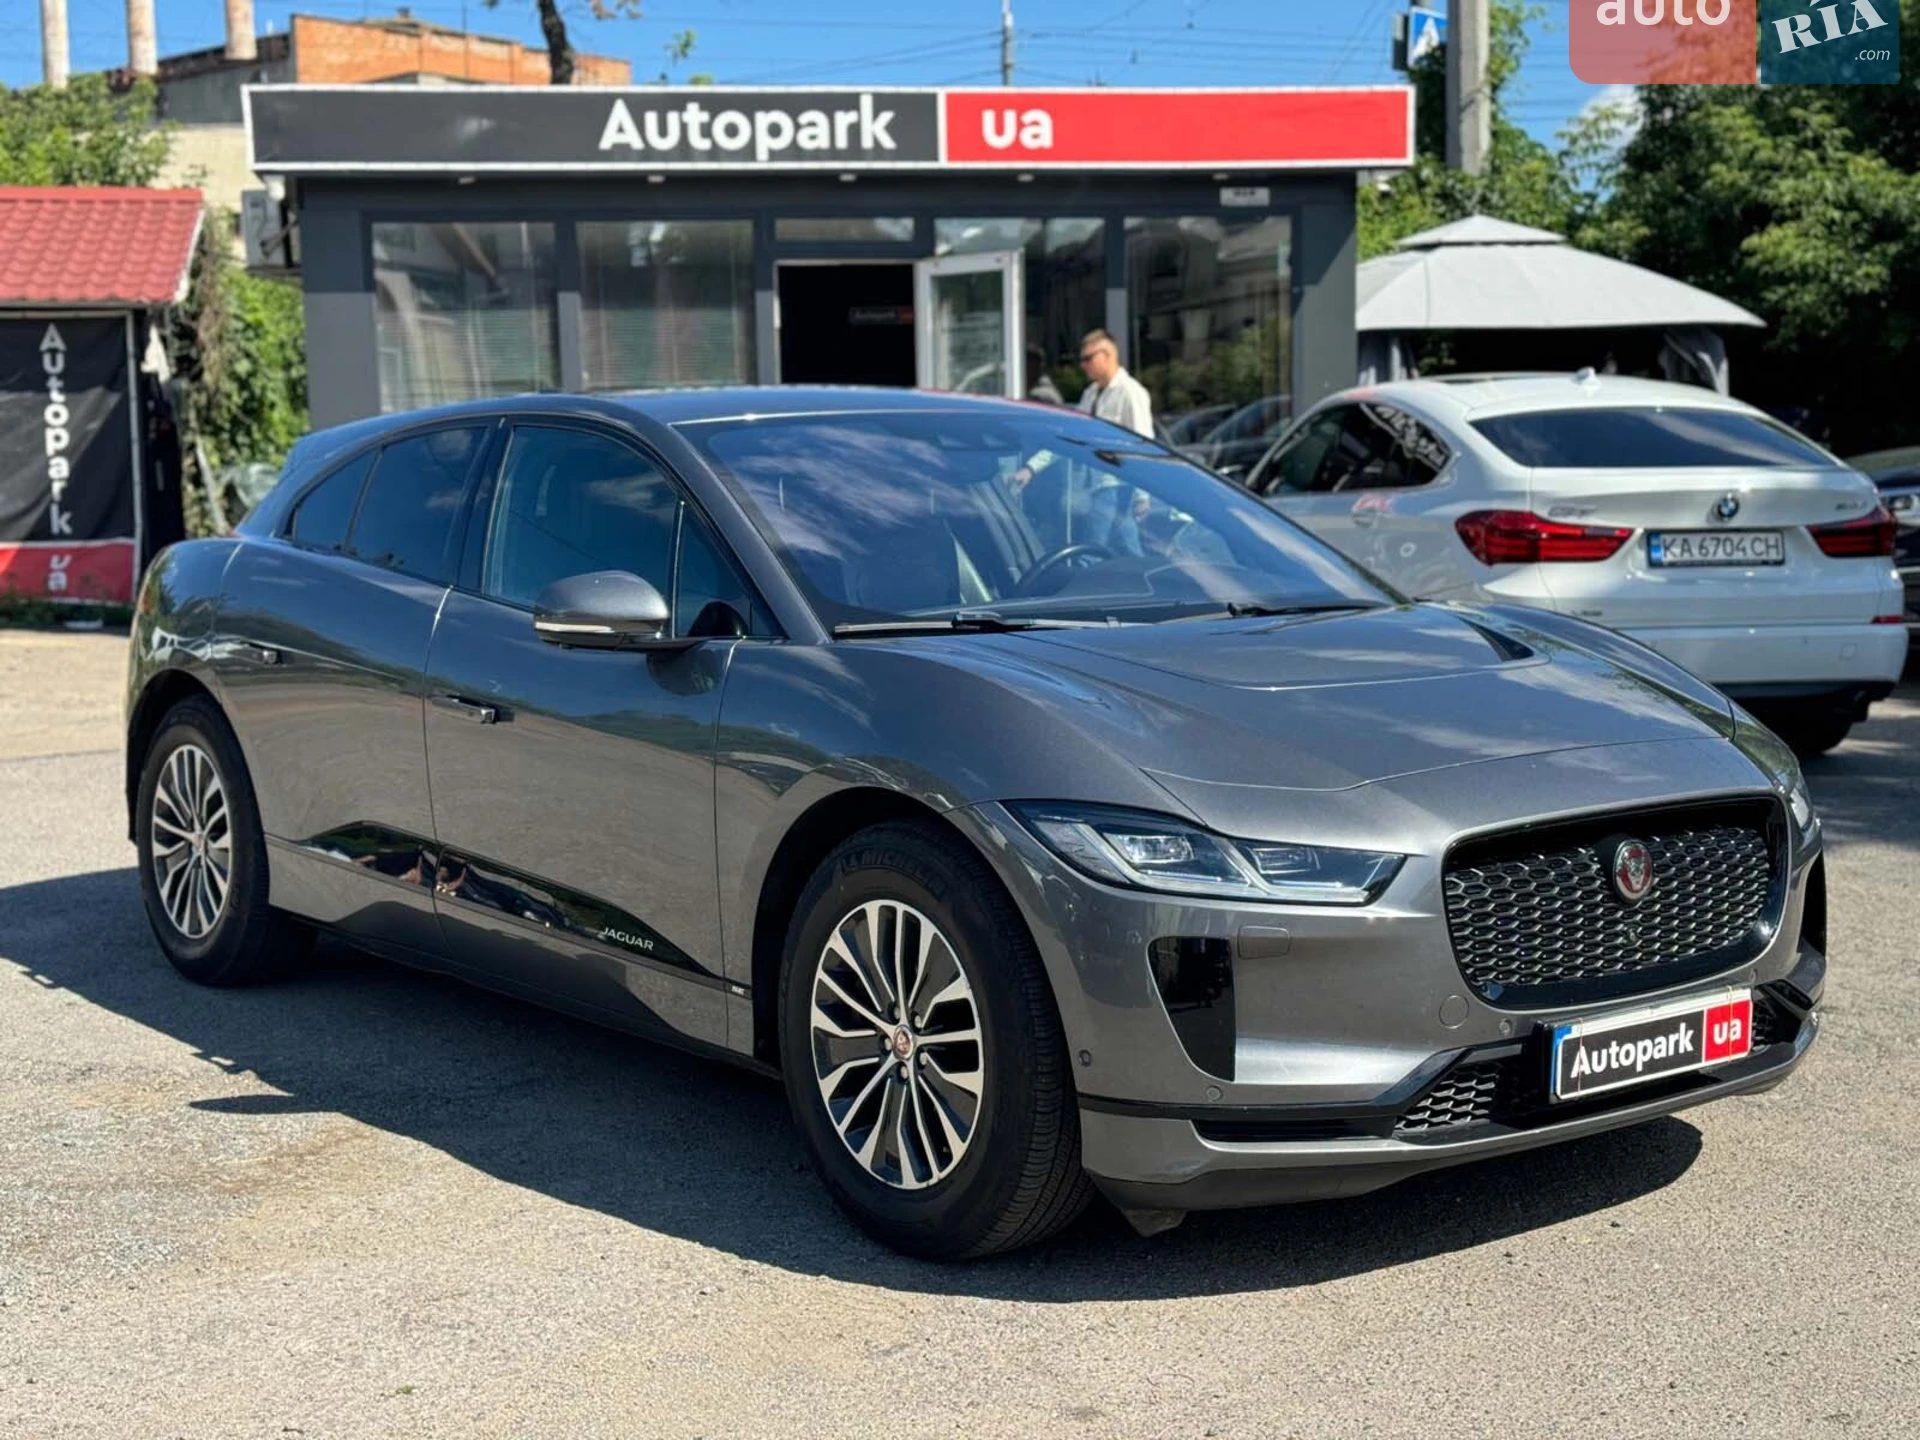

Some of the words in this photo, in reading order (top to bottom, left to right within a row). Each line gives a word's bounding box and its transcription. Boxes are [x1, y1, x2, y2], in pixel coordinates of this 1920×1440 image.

[599, 93, 897, 162] Autopark
[981, 108, 1054, 149] ua
[39, 323, 73, 535] Autopark
[1699, 537, 1748, 557] 6704
[600, 926, 654, 951] JAGUAR
[1570, 1022, 1695, 1079] Autopark
[1713, 1018, 1742, 1045] ua
